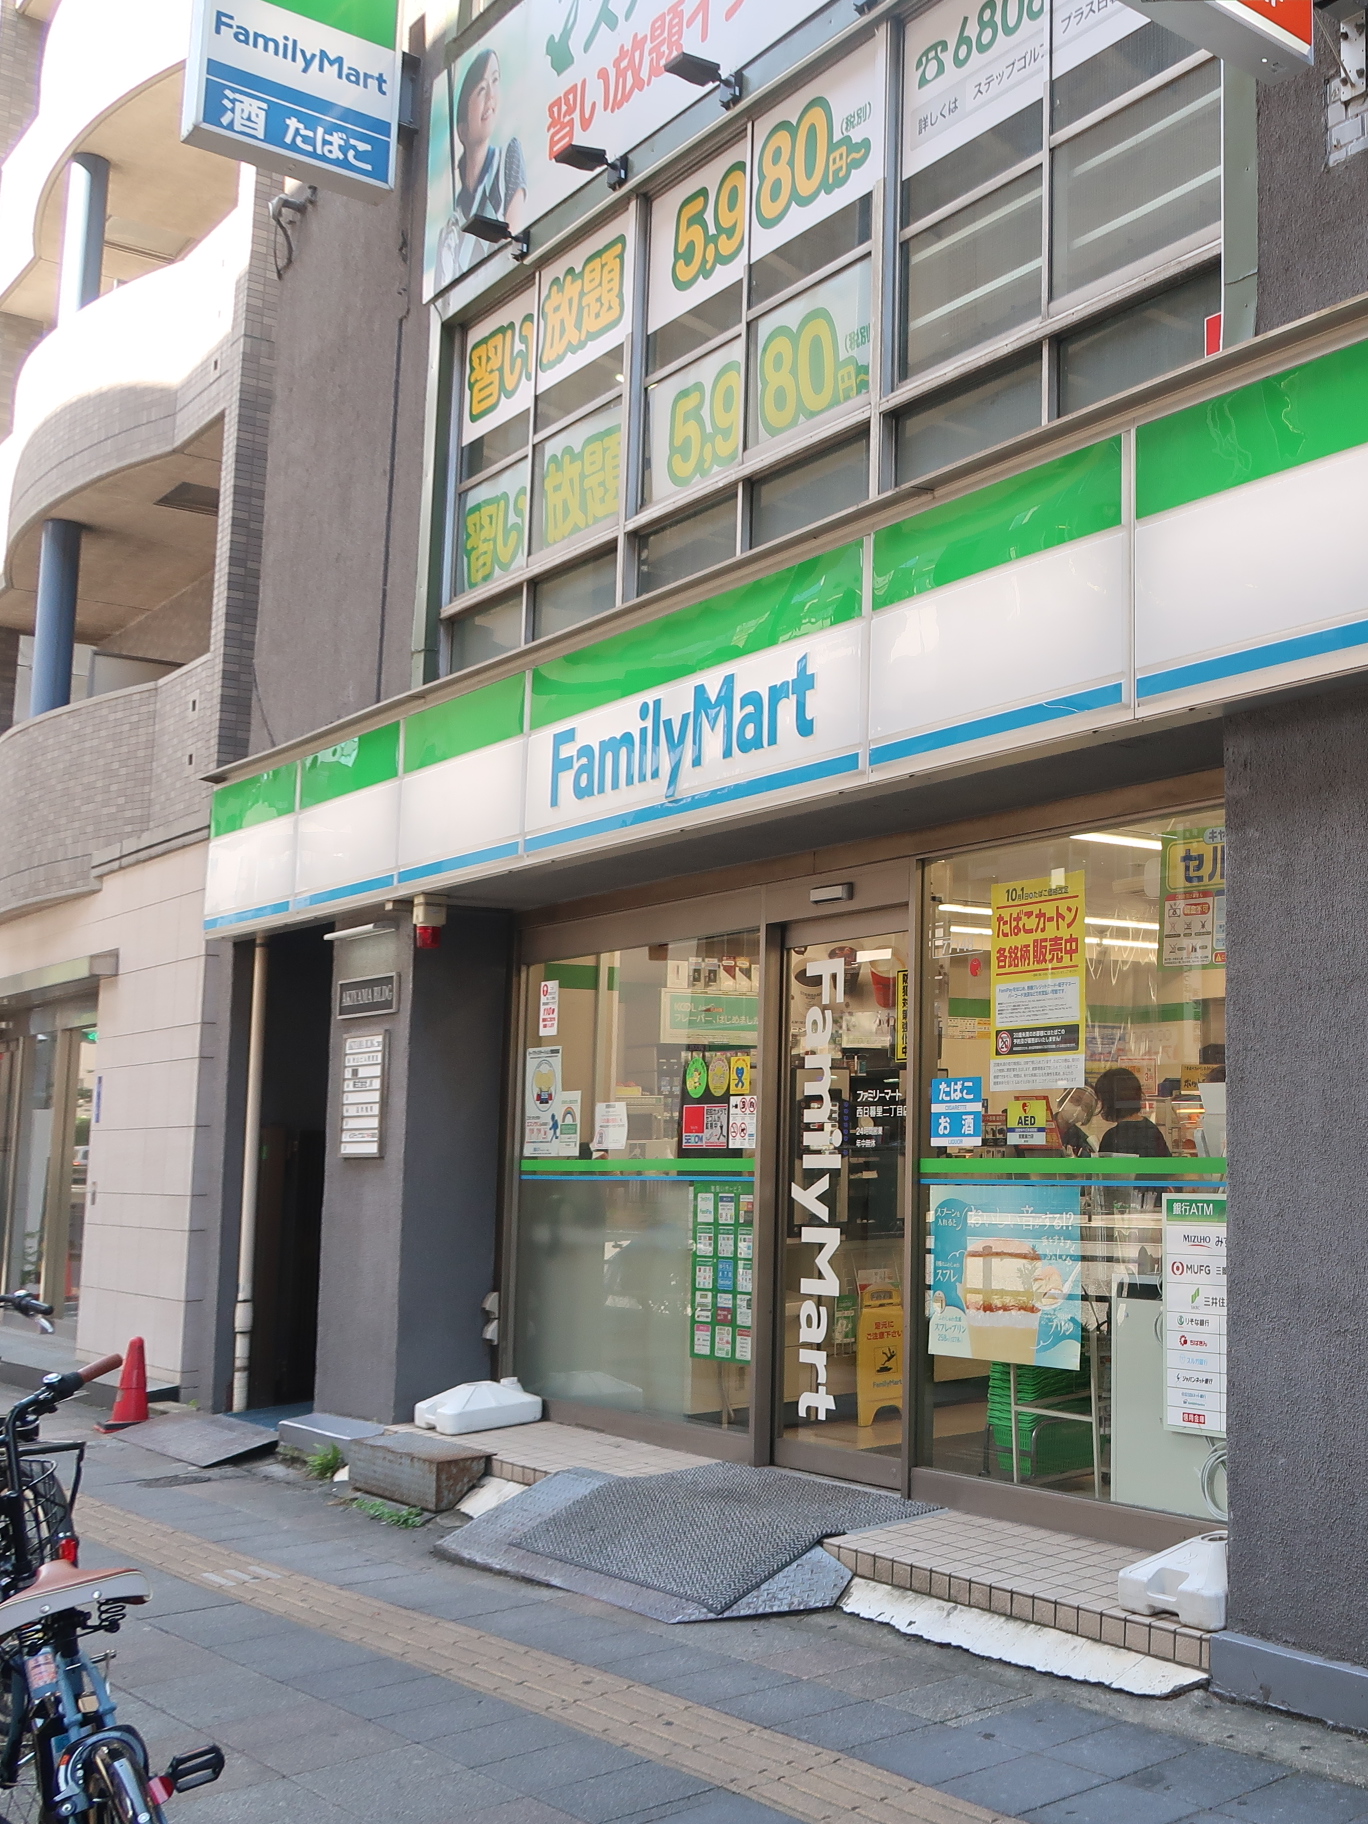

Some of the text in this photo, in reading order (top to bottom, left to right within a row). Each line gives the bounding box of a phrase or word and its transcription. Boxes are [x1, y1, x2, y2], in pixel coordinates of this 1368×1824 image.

[213, 8, 388, 97] FamilyMart
[917, 96, 959, 136] 詳しくは
[219, 89, 374, 172] 酒 たばこ
[550, 652, 816, 808] FamilyMart
[996, 905, 1079, 938] たばこカートン
[996, 933, 1079, 970] 各銘柄販売中
[856, 1089, 902, 1102] ファミリーマート
[938, 1080, 974, 1101] たばこ
[1017, 1115, 1036, 1126] AED
[791, 958, 845, 1421] FamilyMart
[1172, 1202, 1214, 1216] 銀行ATM
[1182, 1234, 1211, 1244] MIZUHO
[935, 1269, 959, 1283] スフレ
[1185, 1264, 1211, 1276] MUFG
[1185, 1317, 1210, 1328] りそな銀行
